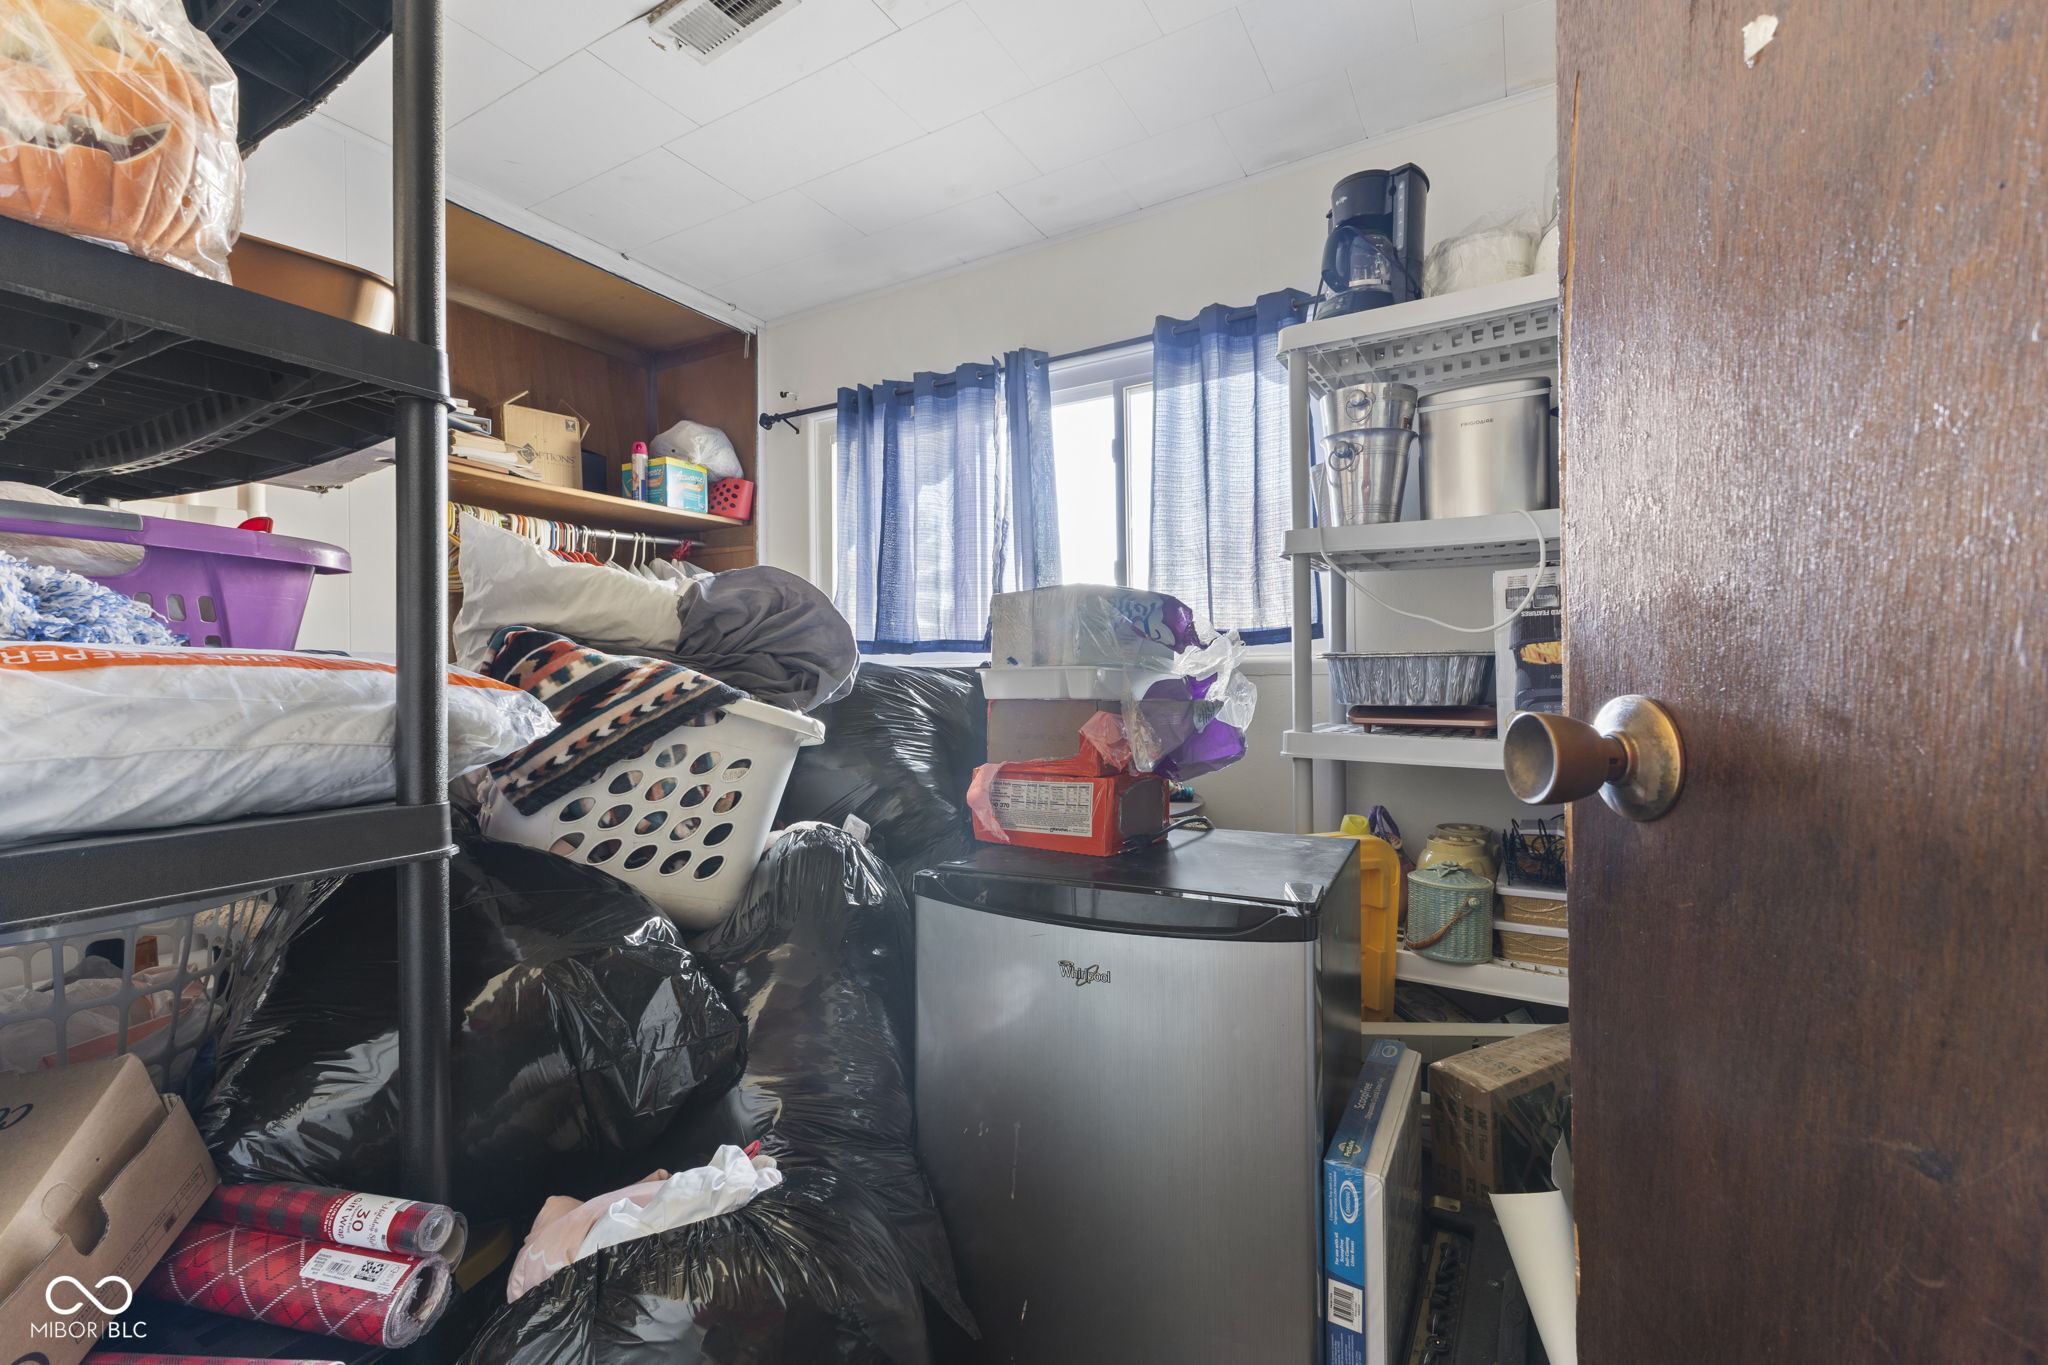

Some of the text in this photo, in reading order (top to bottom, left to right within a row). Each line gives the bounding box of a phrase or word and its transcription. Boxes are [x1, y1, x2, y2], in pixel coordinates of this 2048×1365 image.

[1058, 960, 1111, 986] Whirlpool
[338, 1197, 363, 1239] Gift Wrap
[352, 1208, 371, 1232] 30
